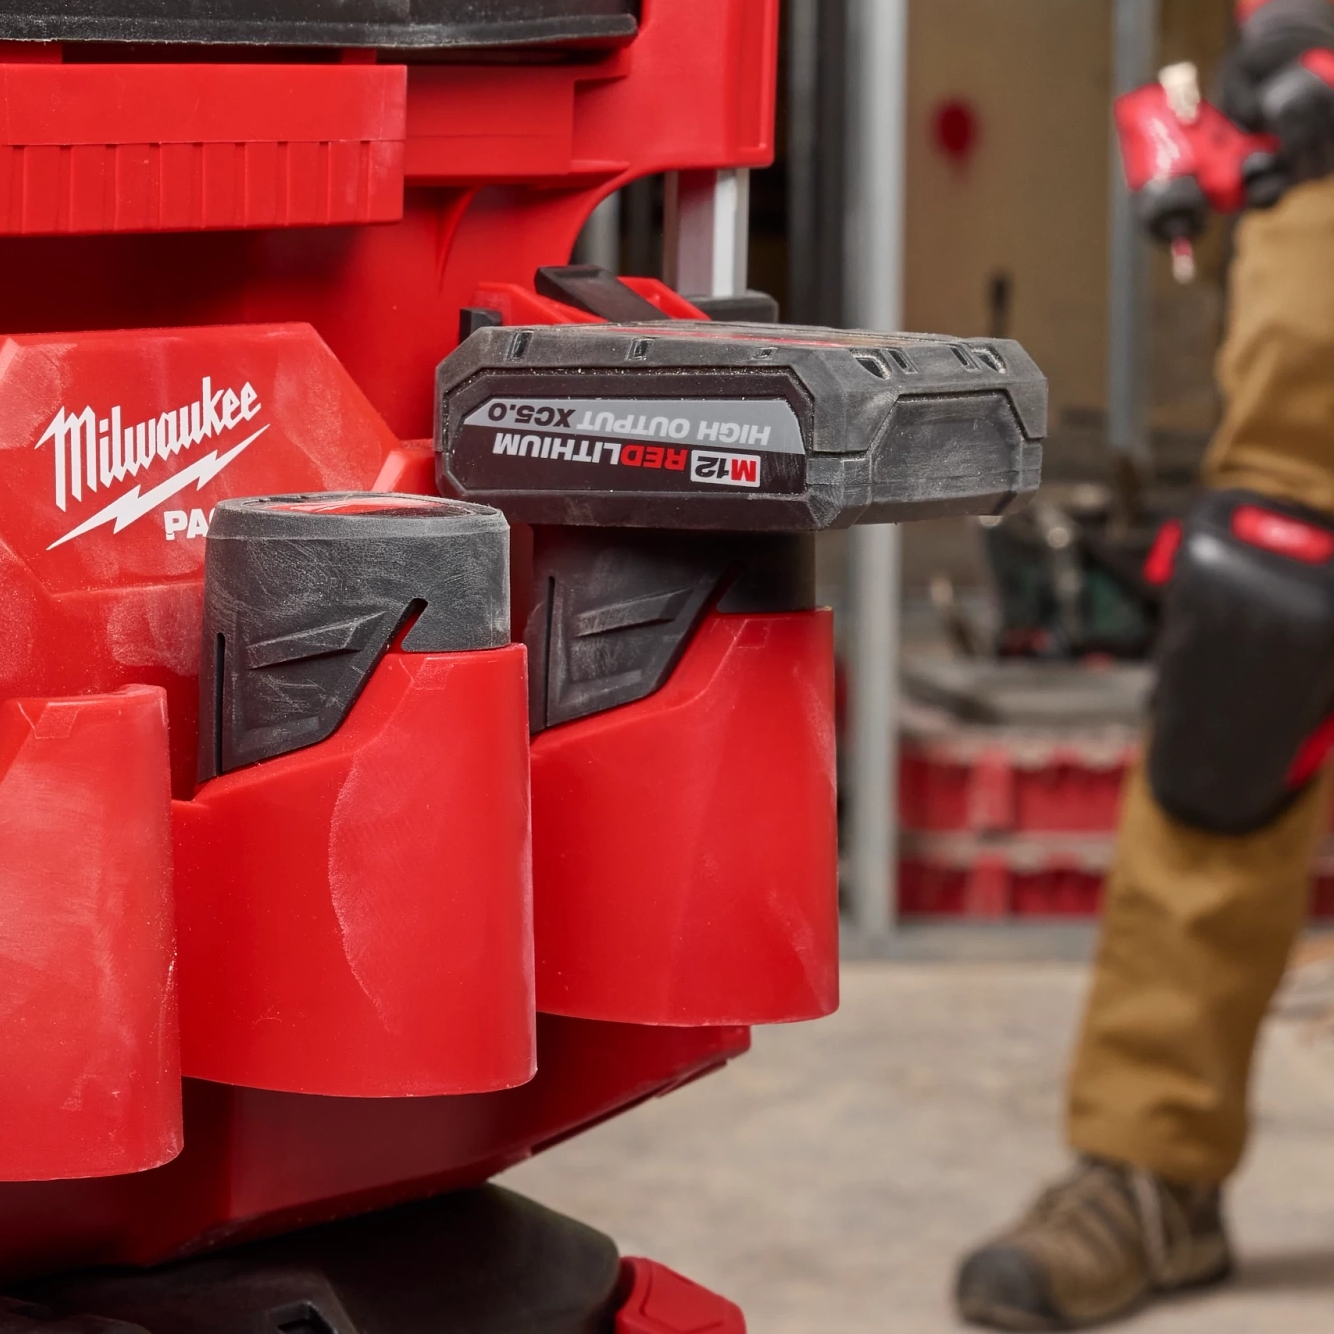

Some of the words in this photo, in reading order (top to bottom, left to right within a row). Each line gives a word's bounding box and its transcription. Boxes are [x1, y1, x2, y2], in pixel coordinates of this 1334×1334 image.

[488, 402, 575, 428] XC5.0
[576, 410, 690, 438] OUTPUT
[34, 376, 261, 512] Milwaukee
[697, 421, 771, 446] HIGH
[694, 455, 757, 483] M12
